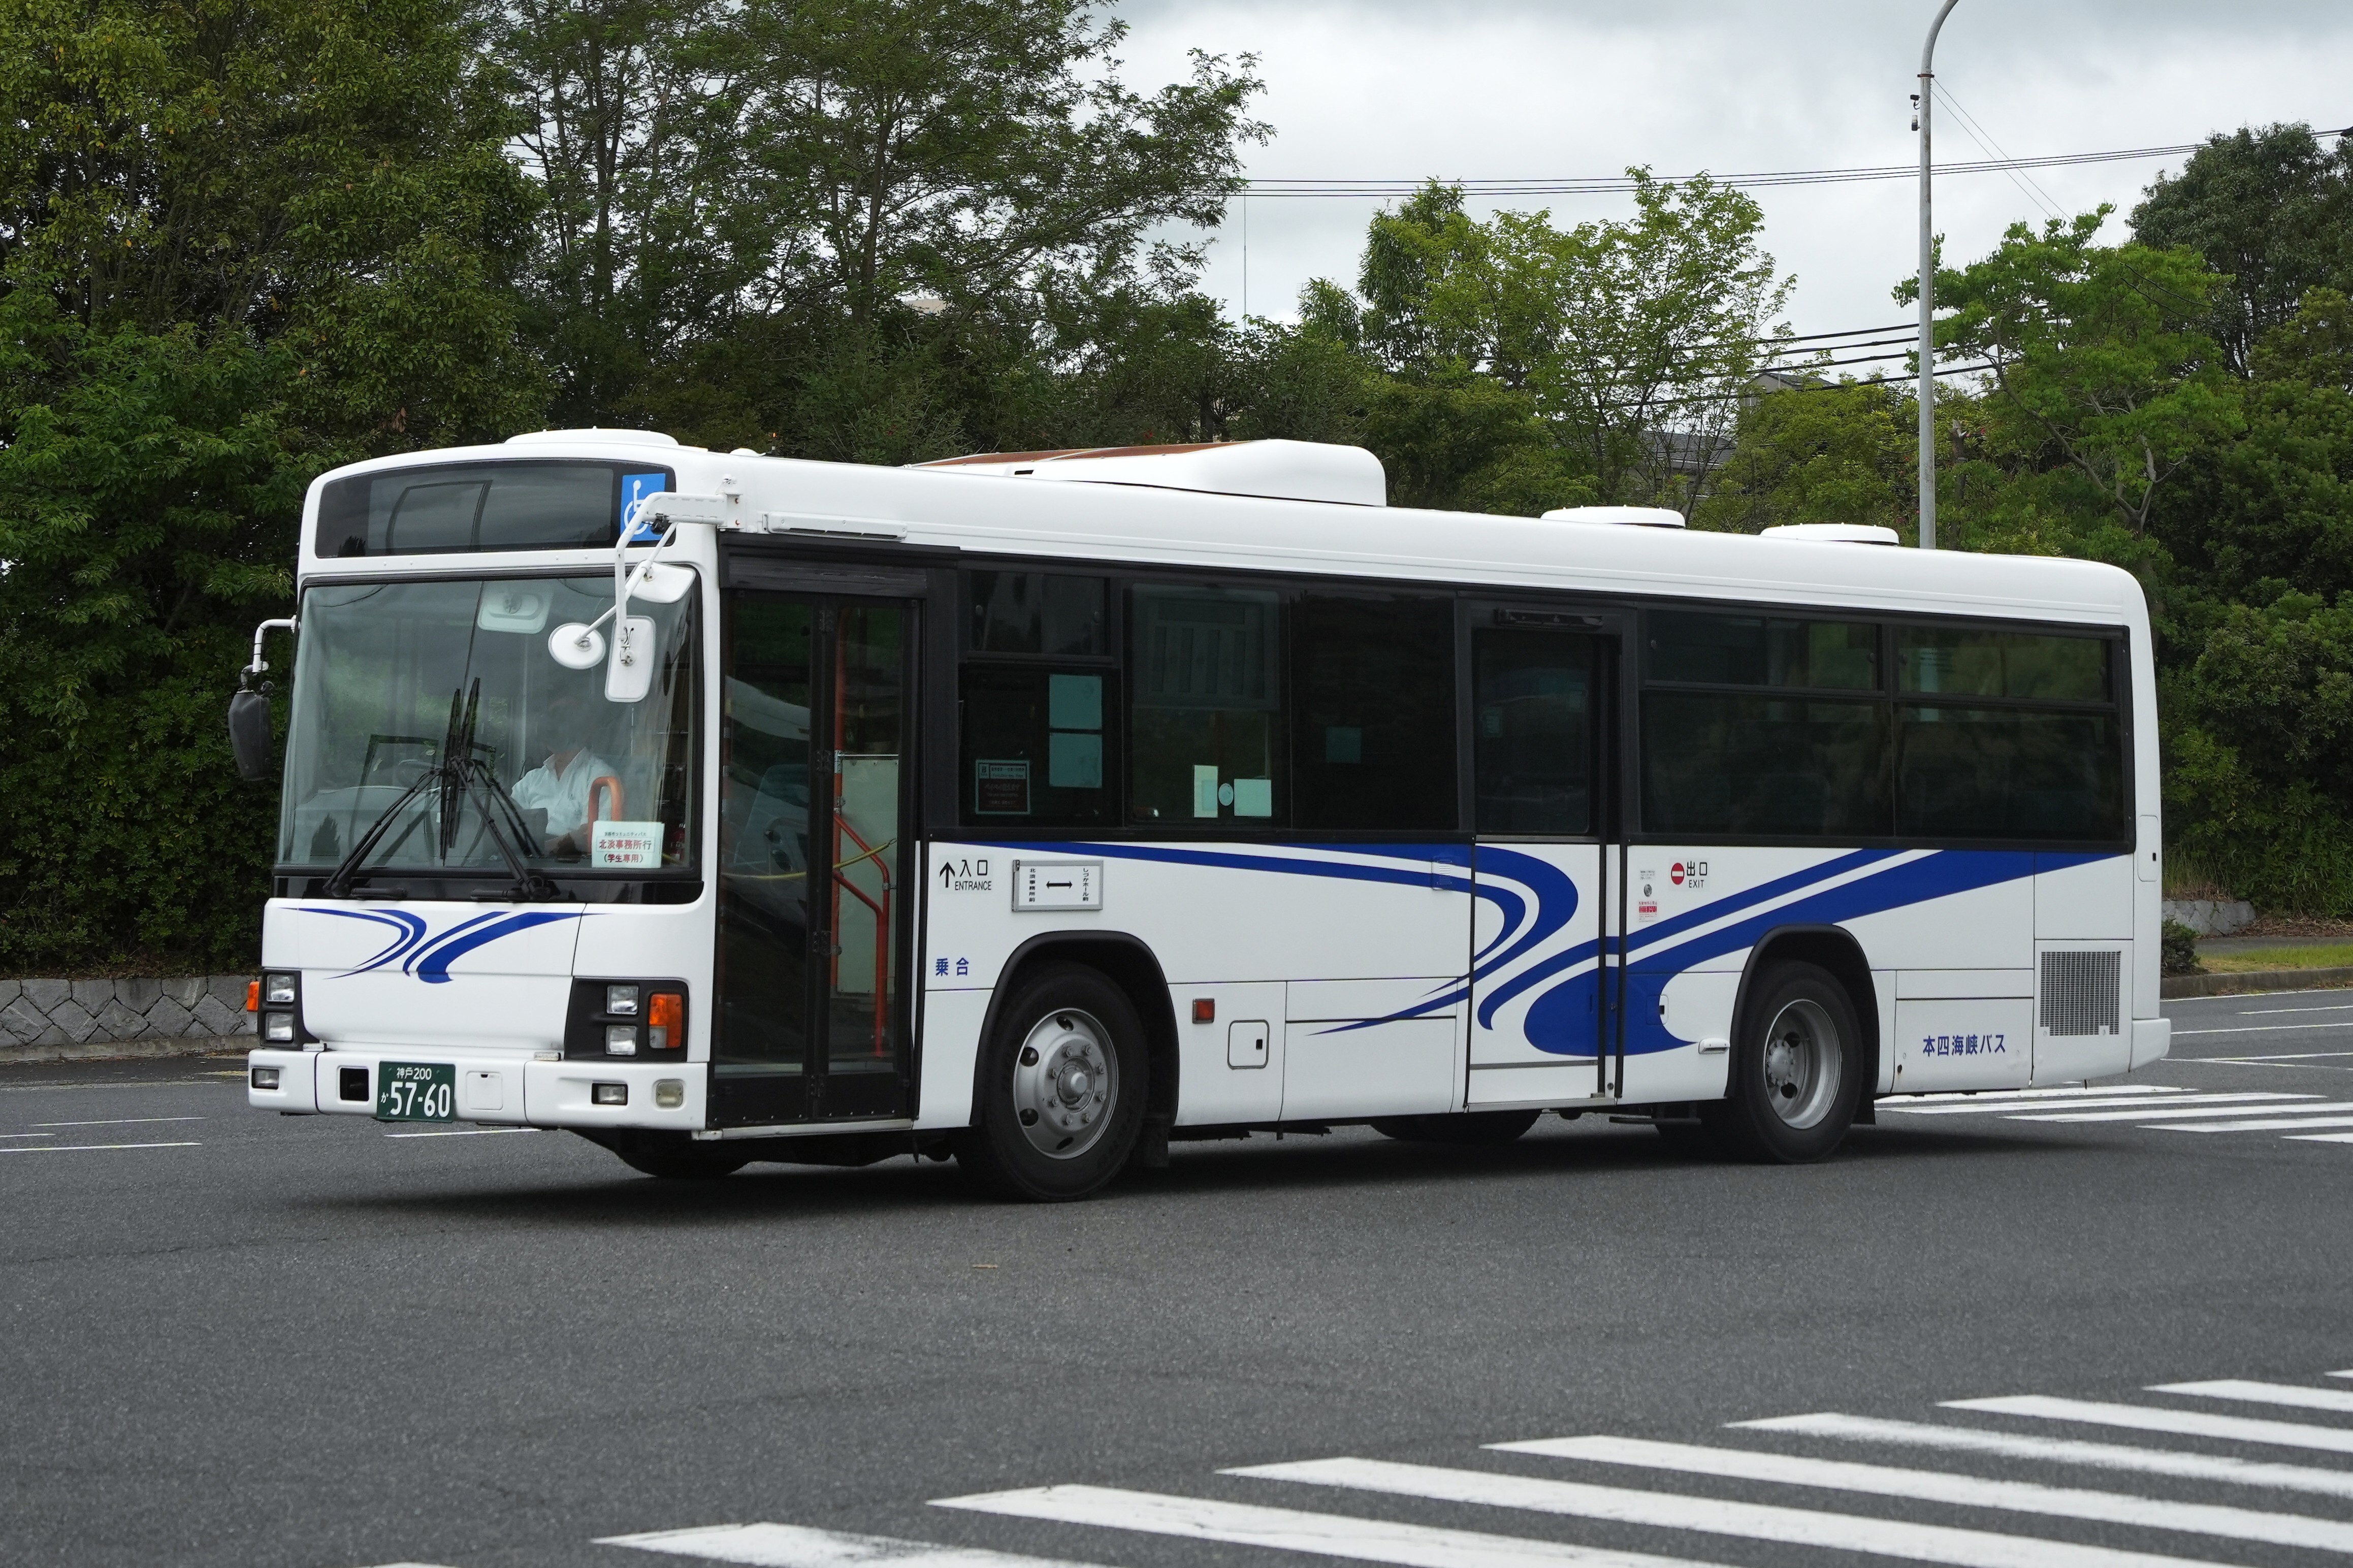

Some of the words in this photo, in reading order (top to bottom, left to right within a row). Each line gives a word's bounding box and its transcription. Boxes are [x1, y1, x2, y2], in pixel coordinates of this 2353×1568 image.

[599, 839, 652, 851] 北淡事務所行
[959, 859, 988, 878] 入口
[1686, 861, 1708, 876] 出口
[954, 880, 992, 891] ENTRANCE
[1688, 879, 1705, 889] EXIT
[935, 957, 969, 976] 乗合
[1922, 1034, 2006, 1057] 本四海峡バス
[380, 1092, 389, 1103] か
[390, 1081, 451, 1118] 57-60
